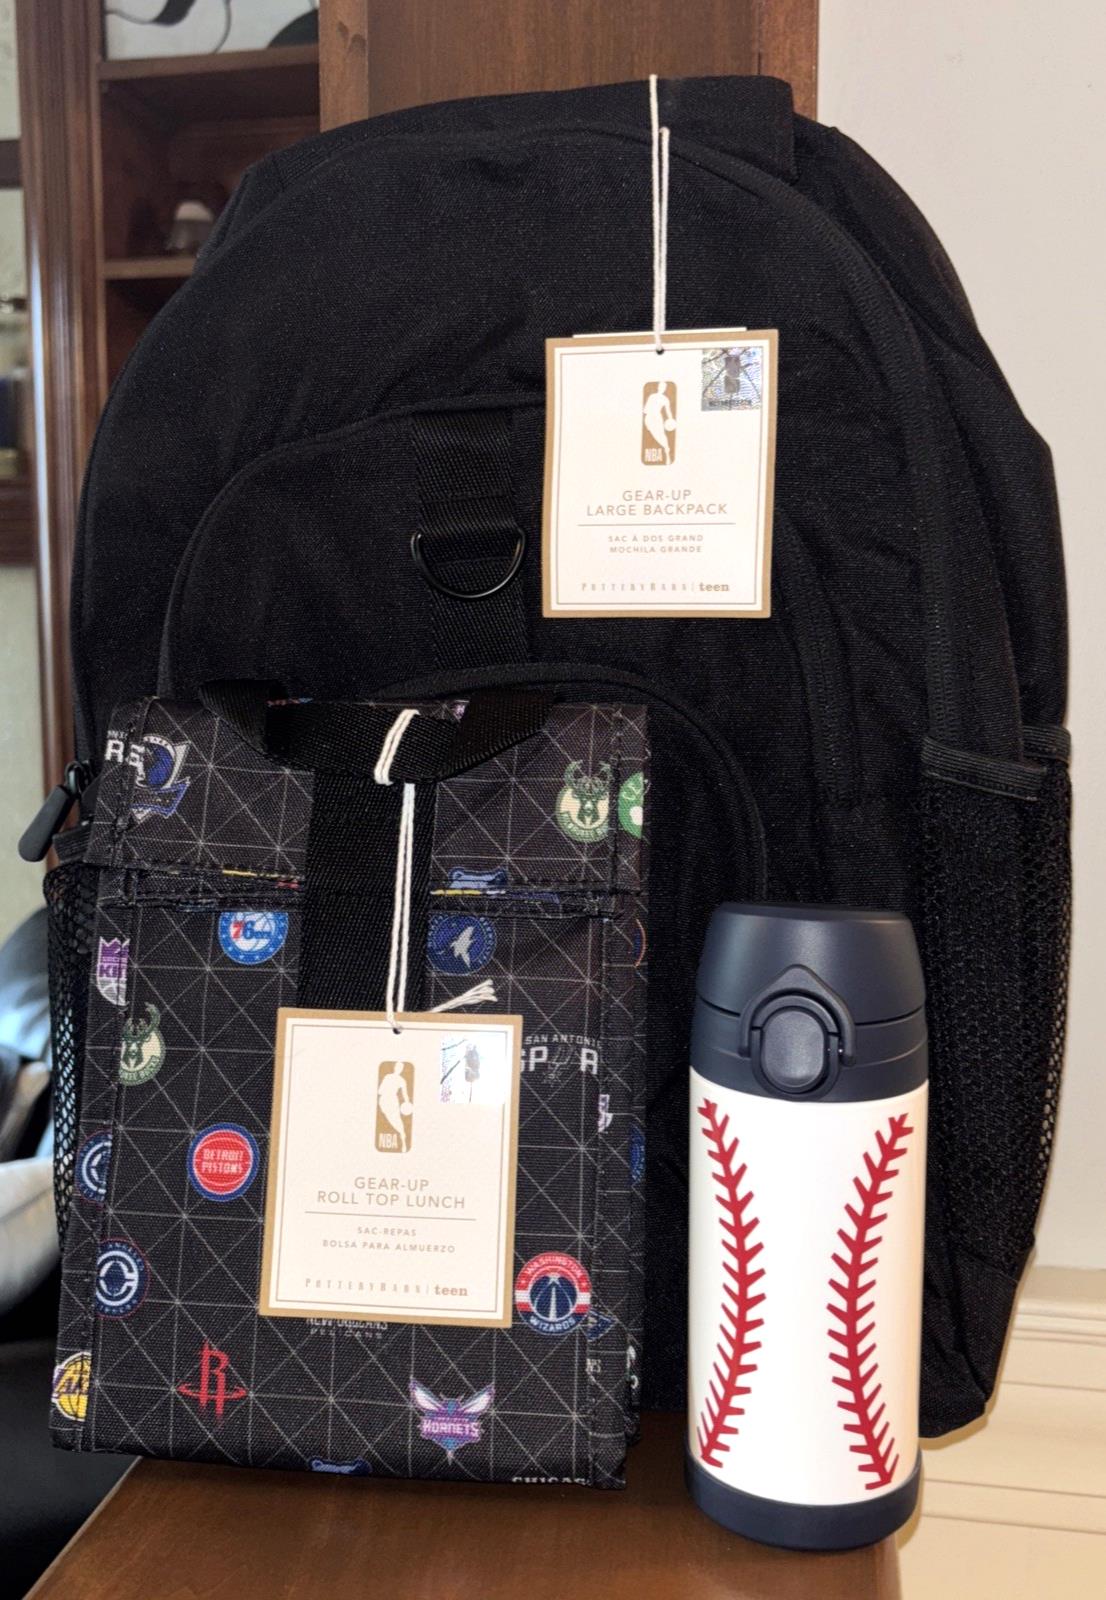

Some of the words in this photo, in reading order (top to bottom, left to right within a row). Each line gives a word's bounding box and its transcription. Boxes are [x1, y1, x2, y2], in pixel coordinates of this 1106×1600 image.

[644, 447, 664, 462] NBA
[622, 489, 692, 502] GEAR-UP
[586, 504, 637, 517] LARGE
[643, 503, 728, 515] BACKPACK
[643, 535, 663, 543] DOS
[668, 534, 704, 542] GRAND
[660, 545, 702, 553] GRANDE
[699, 582, 730, 592] teen
[525, 1035, 548, 1045] SAN
[378, 1132, 398, 1149] NBA
[354, 1176, 430, 1192] GEAR-UP
[317, 1190, 359, 1205] ROLL
[366, 1193, 400, 1206] TOP
[406, 1195, 465, 1209] LUNCH
[357, 1226, 417, 1237] SAC-REPAS
[322, 1239, 357, 1249] BOLSA
[362, 1241, 390, 1250] PARA
[395, 1243, 456, 1254] ALMUERZO
[434, 1284, 468, 1297] teen
[530, 1315, 576, 1332] WIZARDS
[421, 1418, 480, 1438] HORNETS
